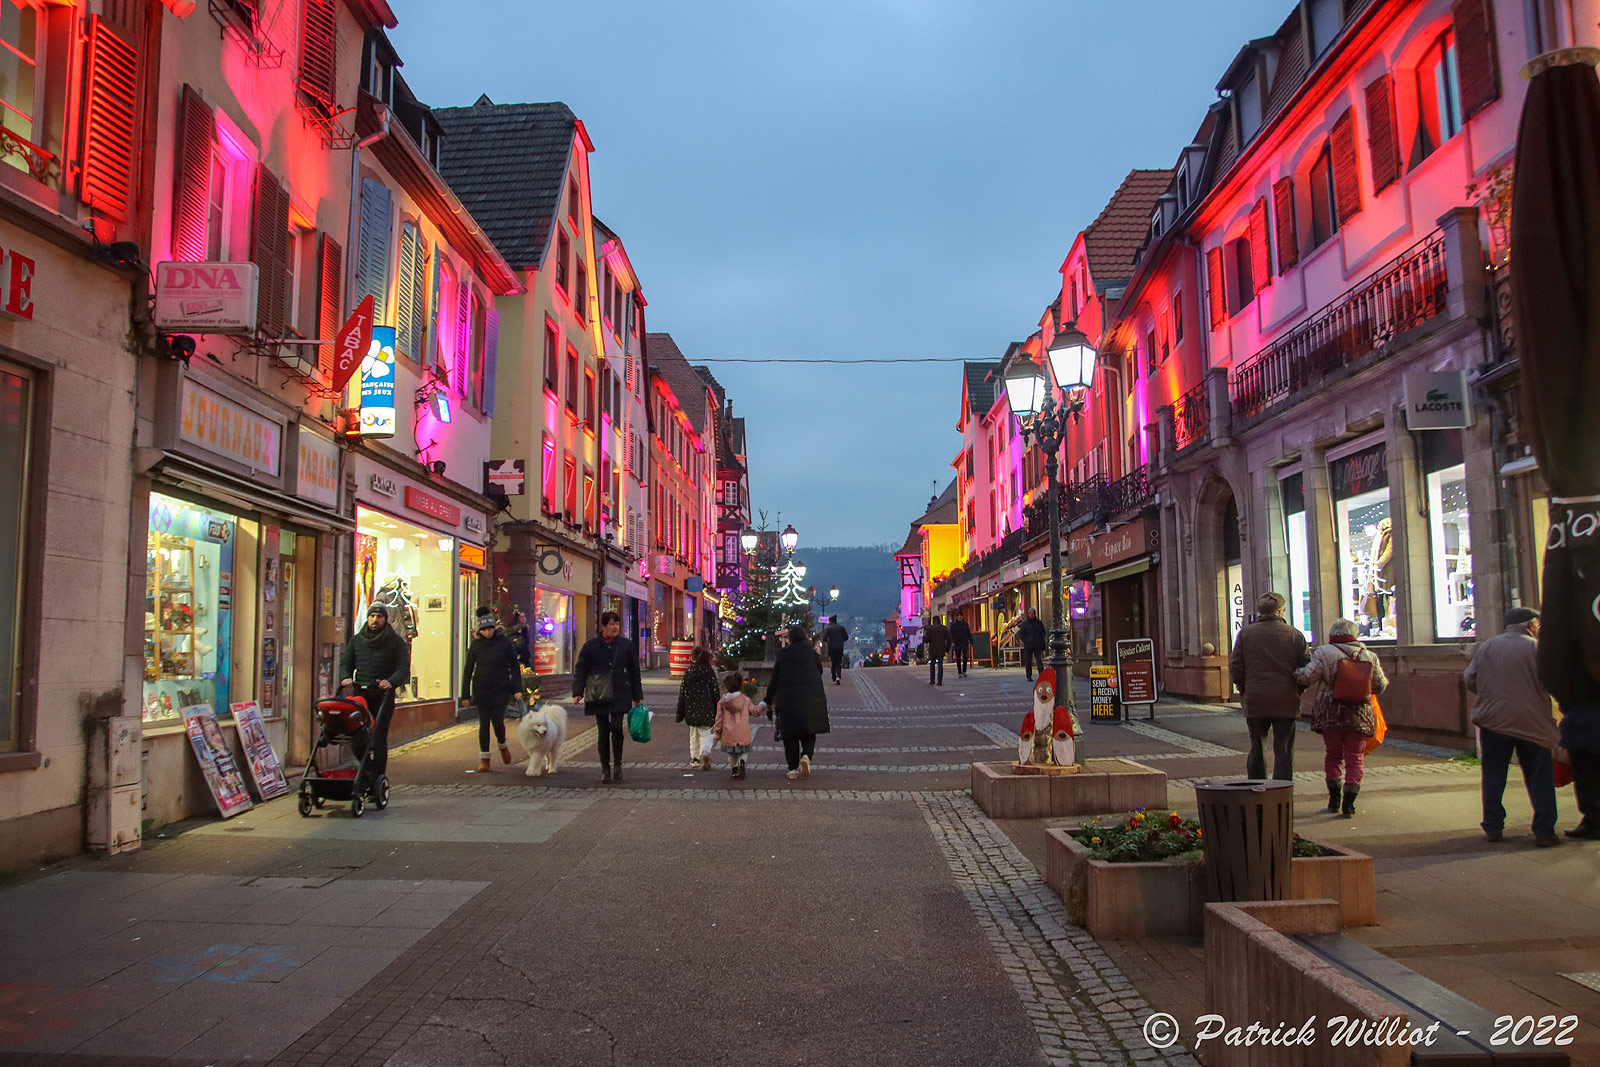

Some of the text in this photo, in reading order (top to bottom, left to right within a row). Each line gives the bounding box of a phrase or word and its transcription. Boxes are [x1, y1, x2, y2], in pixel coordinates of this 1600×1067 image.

[164, 267, 242, 289] DNA
[339, 314, 366, 370] TABAC
[1415, 402, 1462, 412] LACOSTE
[184, 391, 274, 473] JOURNAUX
[300, 444, 337, 492] TABACS
[1105, 541, 1121, 560] Espace
[1092, 679, 1106, 688] SEND
[1092, 688, 1097, 696] &
[1097, 687, 1118, 696] RECEIVE
[1092, 696, 1112, 704] MONEY
[1093, 704, 1114, 716] HERE
